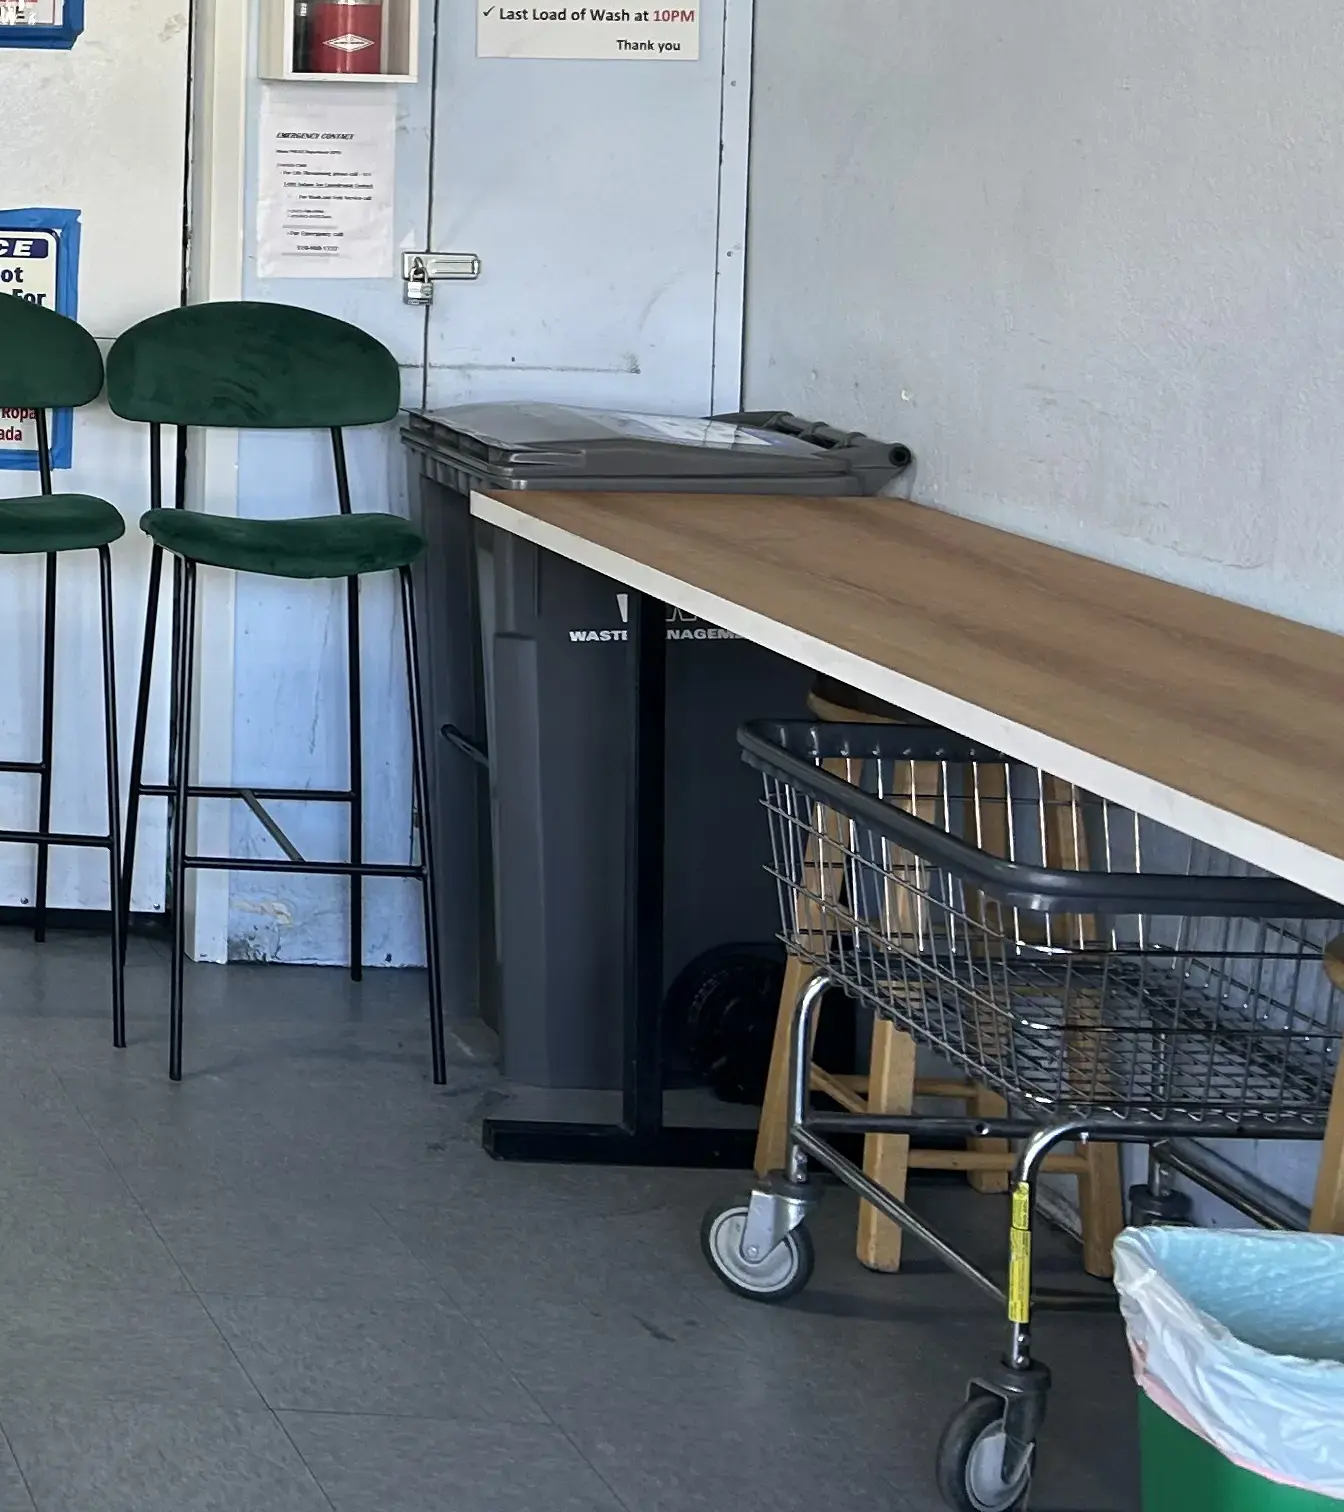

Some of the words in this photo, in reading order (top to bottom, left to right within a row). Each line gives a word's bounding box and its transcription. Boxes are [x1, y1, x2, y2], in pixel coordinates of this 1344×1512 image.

[500, 7, 528, 23] Last
[532, 7, 567, 23] Load
[571, 7, 587, 23] of
[590, 7, 629, 23] Wash
[633, 9, 649, 23] at
[653, 10, 695, 23] 10PM
[616, 38, 655, 52] Thank
[658, 41, 681, 54] you
